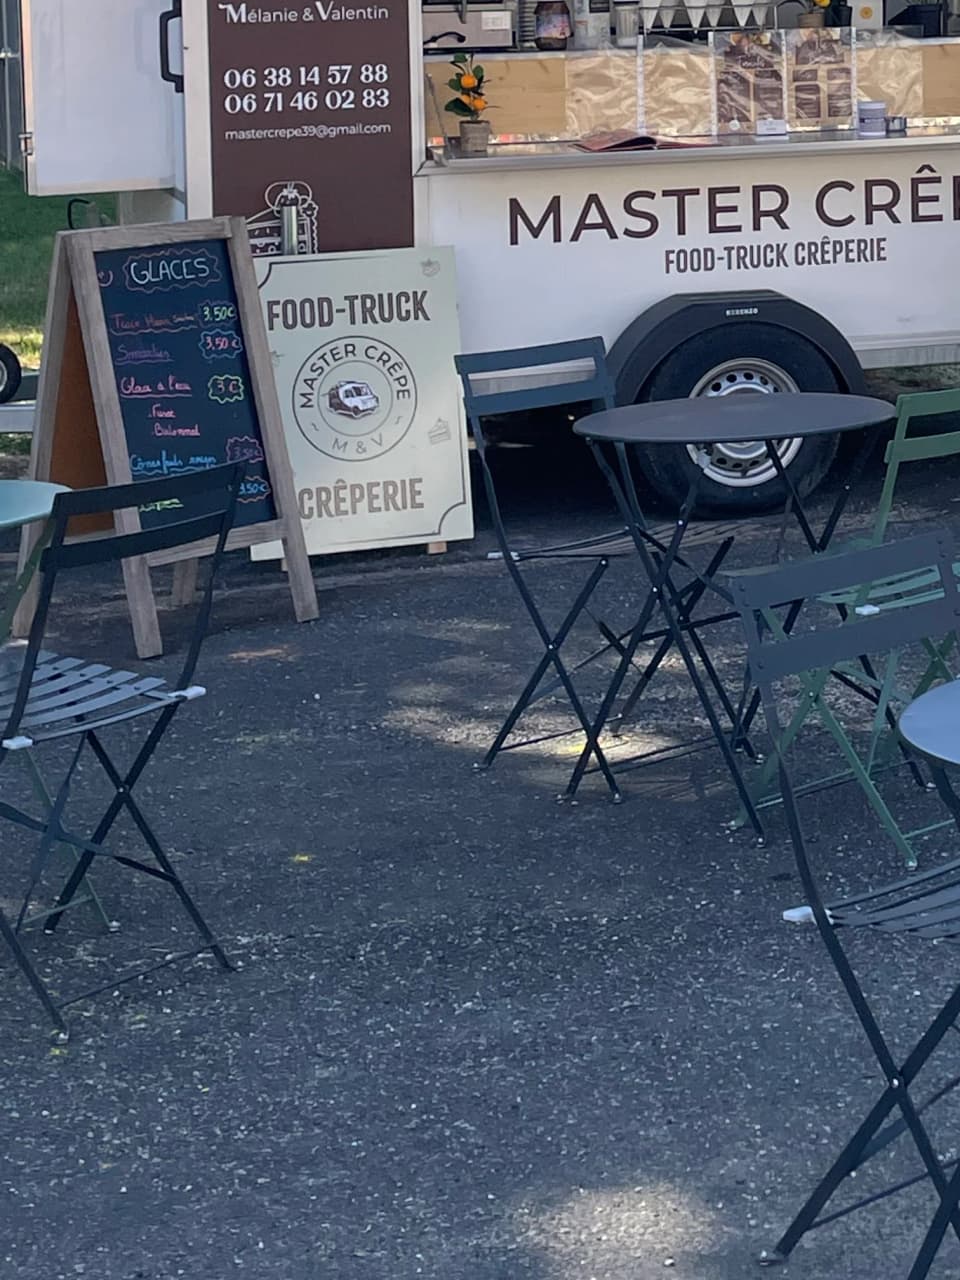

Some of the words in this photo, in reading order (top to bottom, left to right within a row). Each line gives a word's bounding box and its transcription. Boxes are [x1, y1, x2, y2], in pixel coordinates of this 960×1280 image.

[218, 3, 298, 23] Mélanie
[302, 7, 314, 21] &
[315, 1, 389, 20] Valentin
[224, 69, 256, 88] 06
[264, 67, 291, 87] 38
[299, 66, 320, 85] 14
[328, 65, 352, 84] 57
[360, 64, 388, 83] 88
[224, 93, 257, 113] 06
[264, 92, 282, 112] 71
[290, 91, 318, 110] 46
[325, 90, 355, 109] 02
[362, 88, 389, 108] 83
[225, 123, 391, 141] mastercrepe39@gmail.com
[508, 184, 790, 245] MASTER
[664, 242, 788, 274] FOOD-TRUCK
[794, 236, 887, 267] CRÊPERIE
[130, 258, 209, 284] GLACES
[267, 290, 431, 331] FOOD-TRUCK
[300, 343, 358, 409] MASTER
[365, 344, 411, 400] CRÊPE
[332, 437, 347, 453] M
[355, 441, 367, 454] &
[371, 433, 383, 446] V
[298, 478, 424, 520] CRÊPERIE
